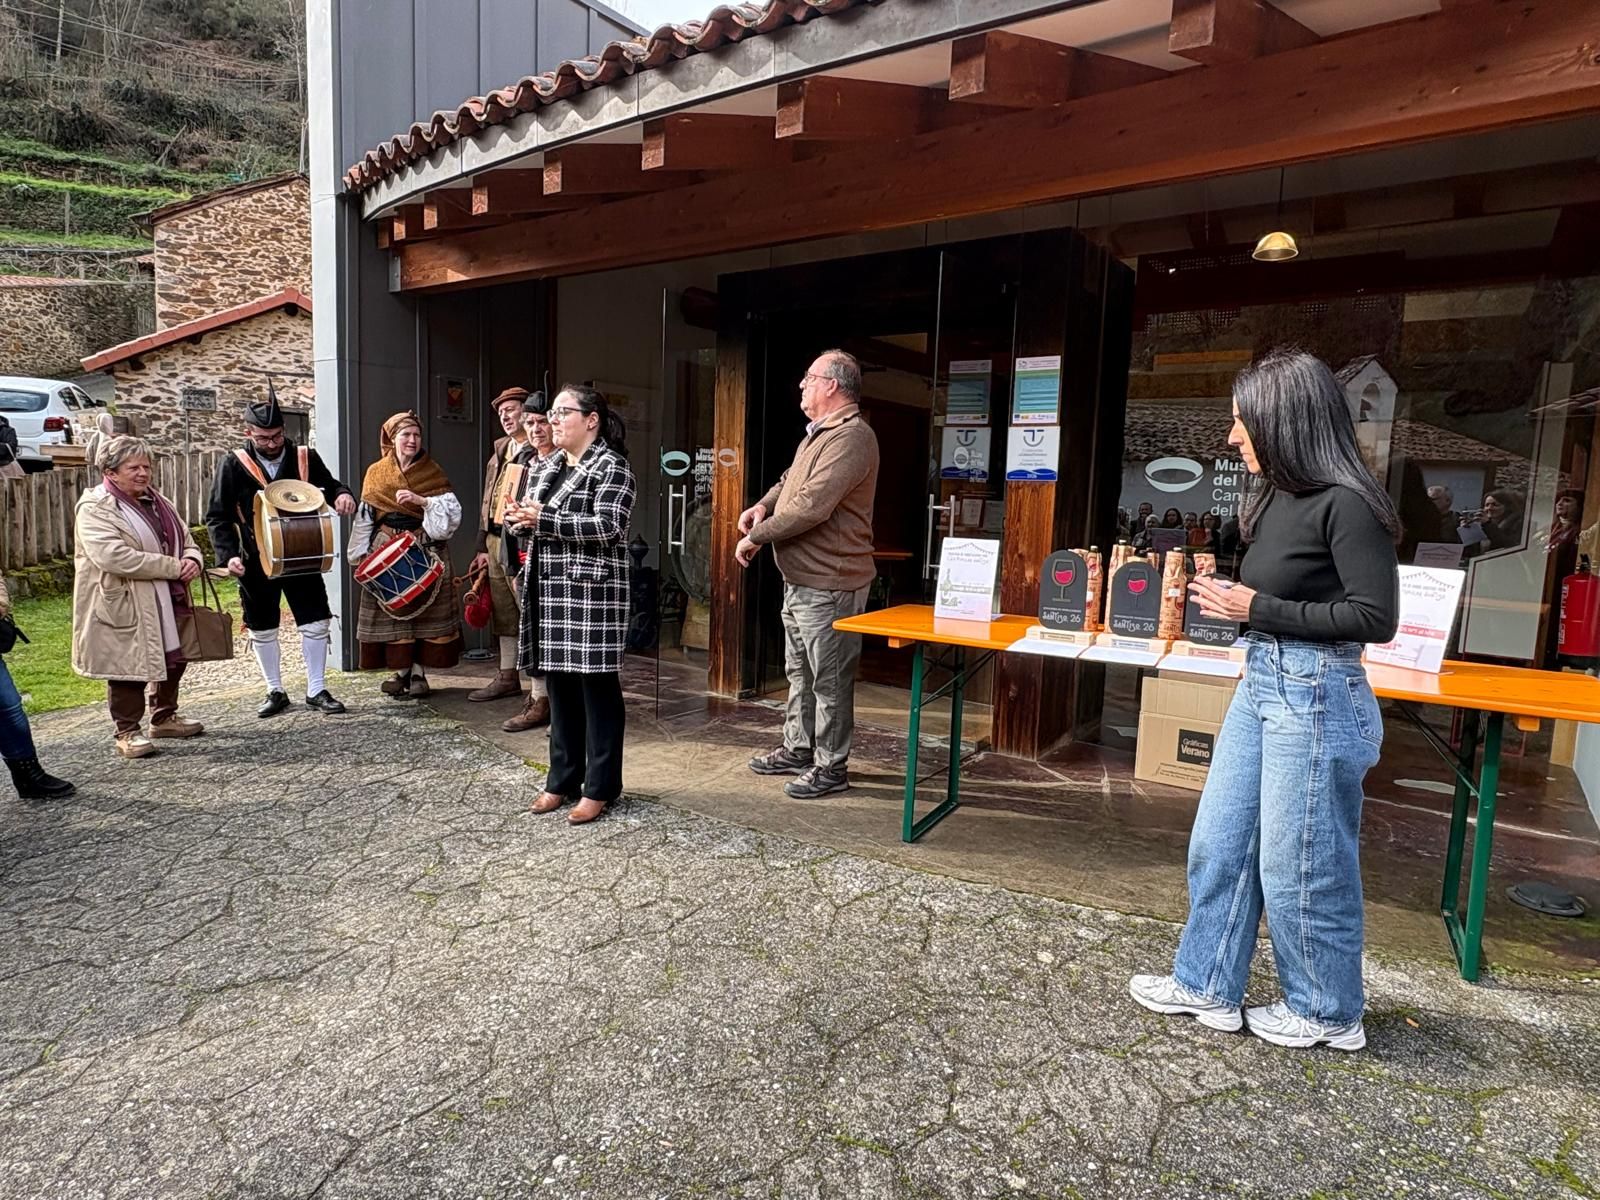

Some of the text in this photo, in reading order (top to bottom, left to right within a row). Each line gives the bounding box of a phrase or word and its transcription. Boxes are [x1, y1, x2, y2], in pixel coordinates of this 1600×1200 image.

[1214, 459, 1247, 471] Mus
[1213, 473, 1237, 486] del
[1210, 504, 1233, 517] del
[1070, 614, 1081, 623] 26
[1143, 622, 1155, 632] 26
[1221, 631, 1234, 641] 26
[1181, 744, 1210, 759] Verano
